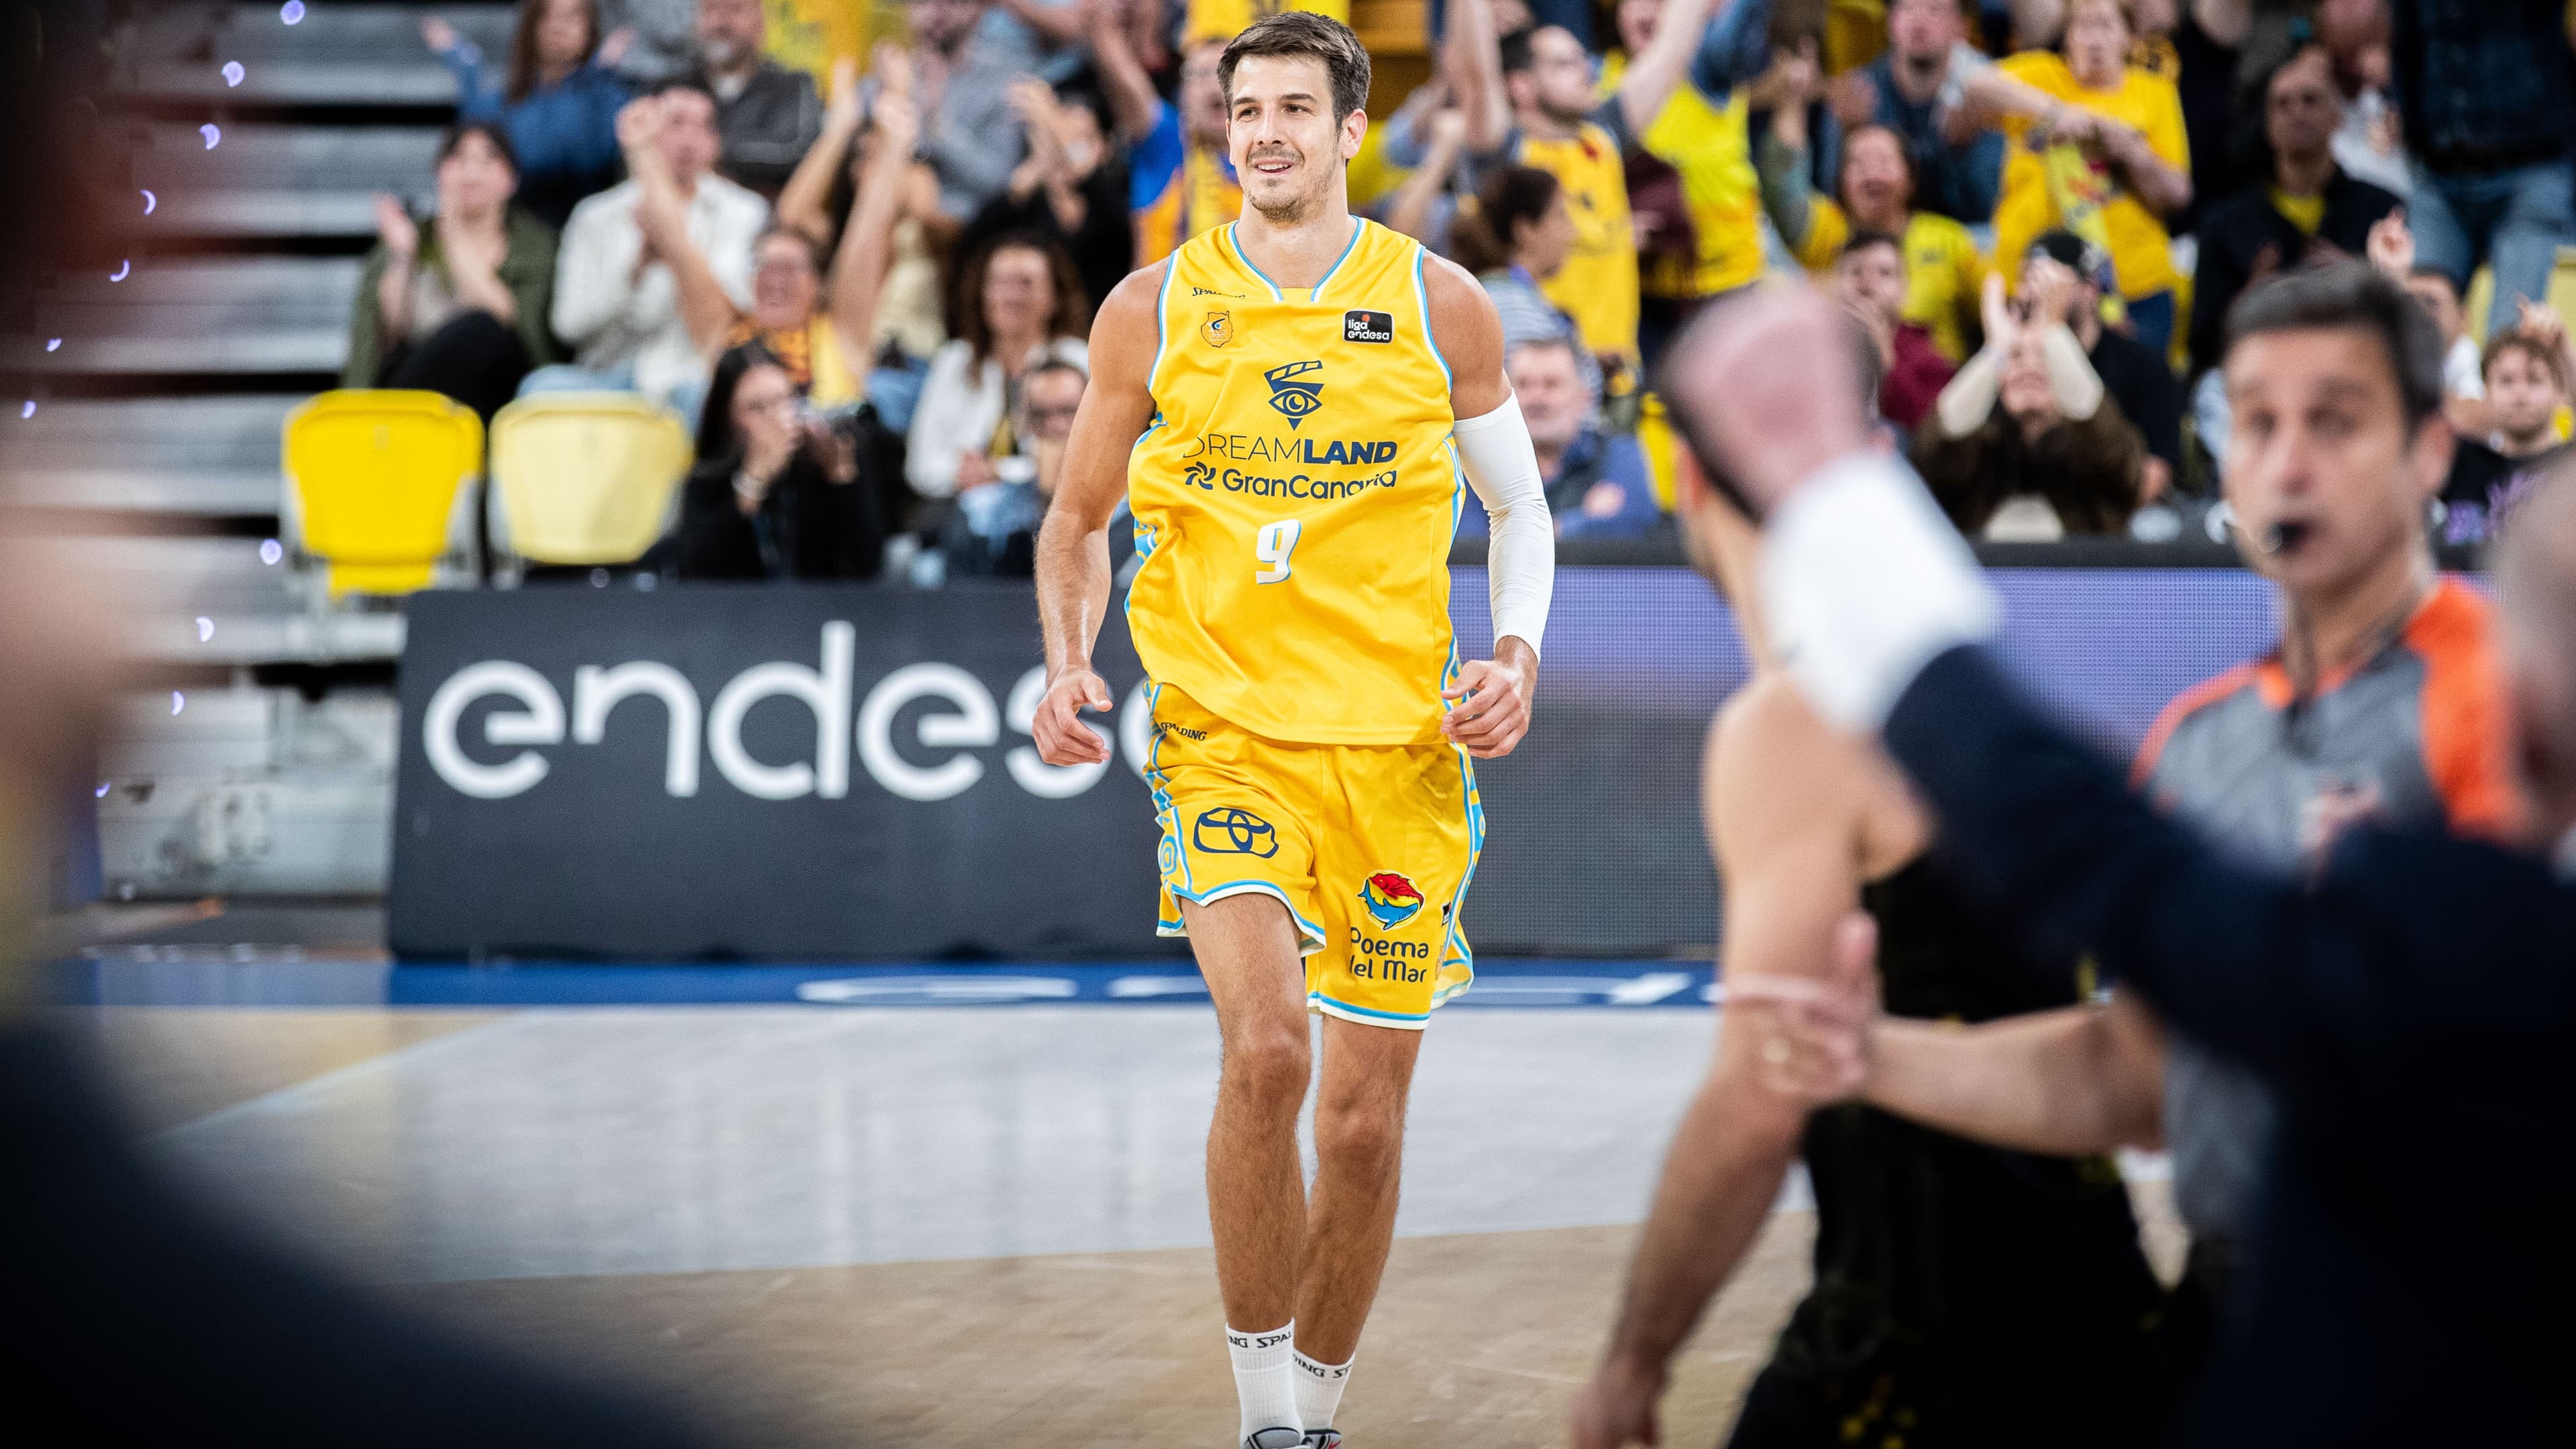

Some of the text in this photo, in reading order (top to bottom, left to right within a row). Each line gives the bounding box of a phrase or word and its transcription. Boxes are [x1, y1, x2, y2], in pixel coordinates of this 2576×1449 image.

[1348, 319, 1368, 331] liga
[1348, 329, 1390, 340] endesa
[1256, 519, 1301, 585] 9
[422, 620, 1152, 800] endes
[1383, 959, 1427, 983] Mar
